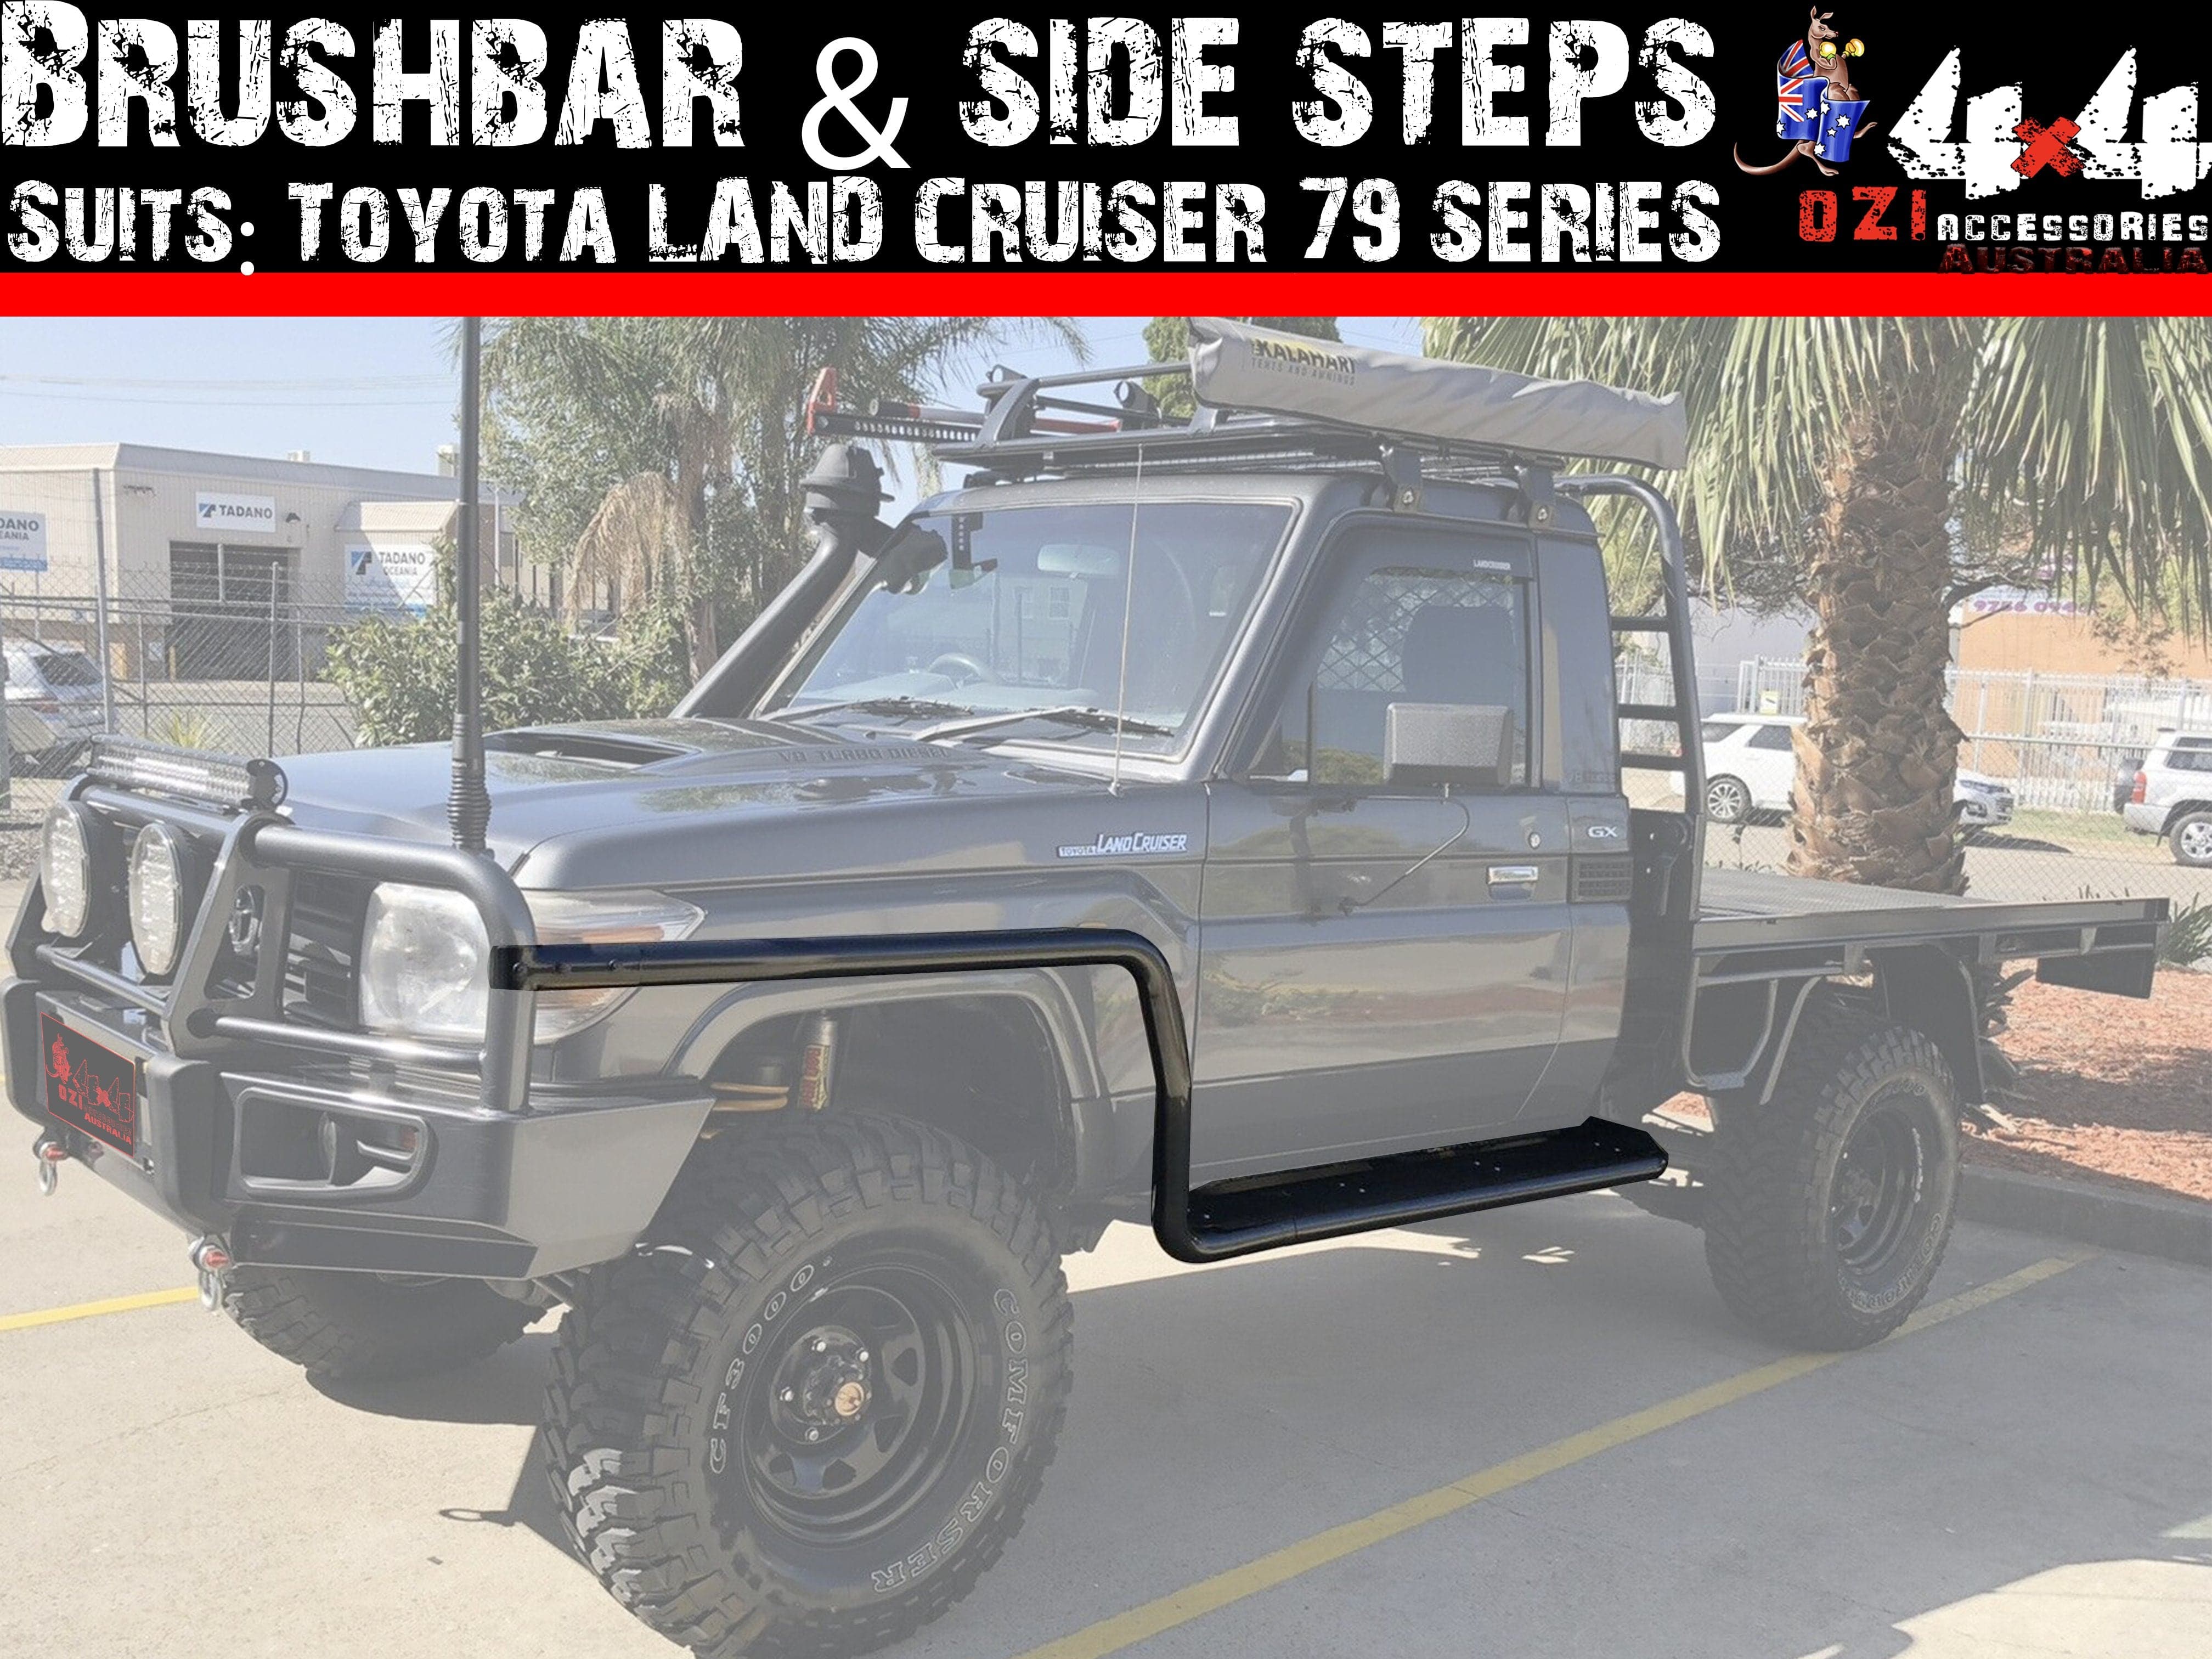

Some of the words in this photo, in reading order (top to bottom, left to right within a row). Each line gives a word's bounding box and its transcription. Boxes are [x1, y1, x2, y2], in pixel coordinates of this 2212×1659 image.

[1254, 337, 1355, 374] KALAHARI
[219, 504, 273, 519] TADANO
[379, 551, 425, 565] TADANO
[384, 565, 418, 575] OCEANIA
[1588, 826, 1618, 838] GX
[710, 1264, 814, 1474] CF3000
[871, 1288, 1028, 1593] COMFORSER
